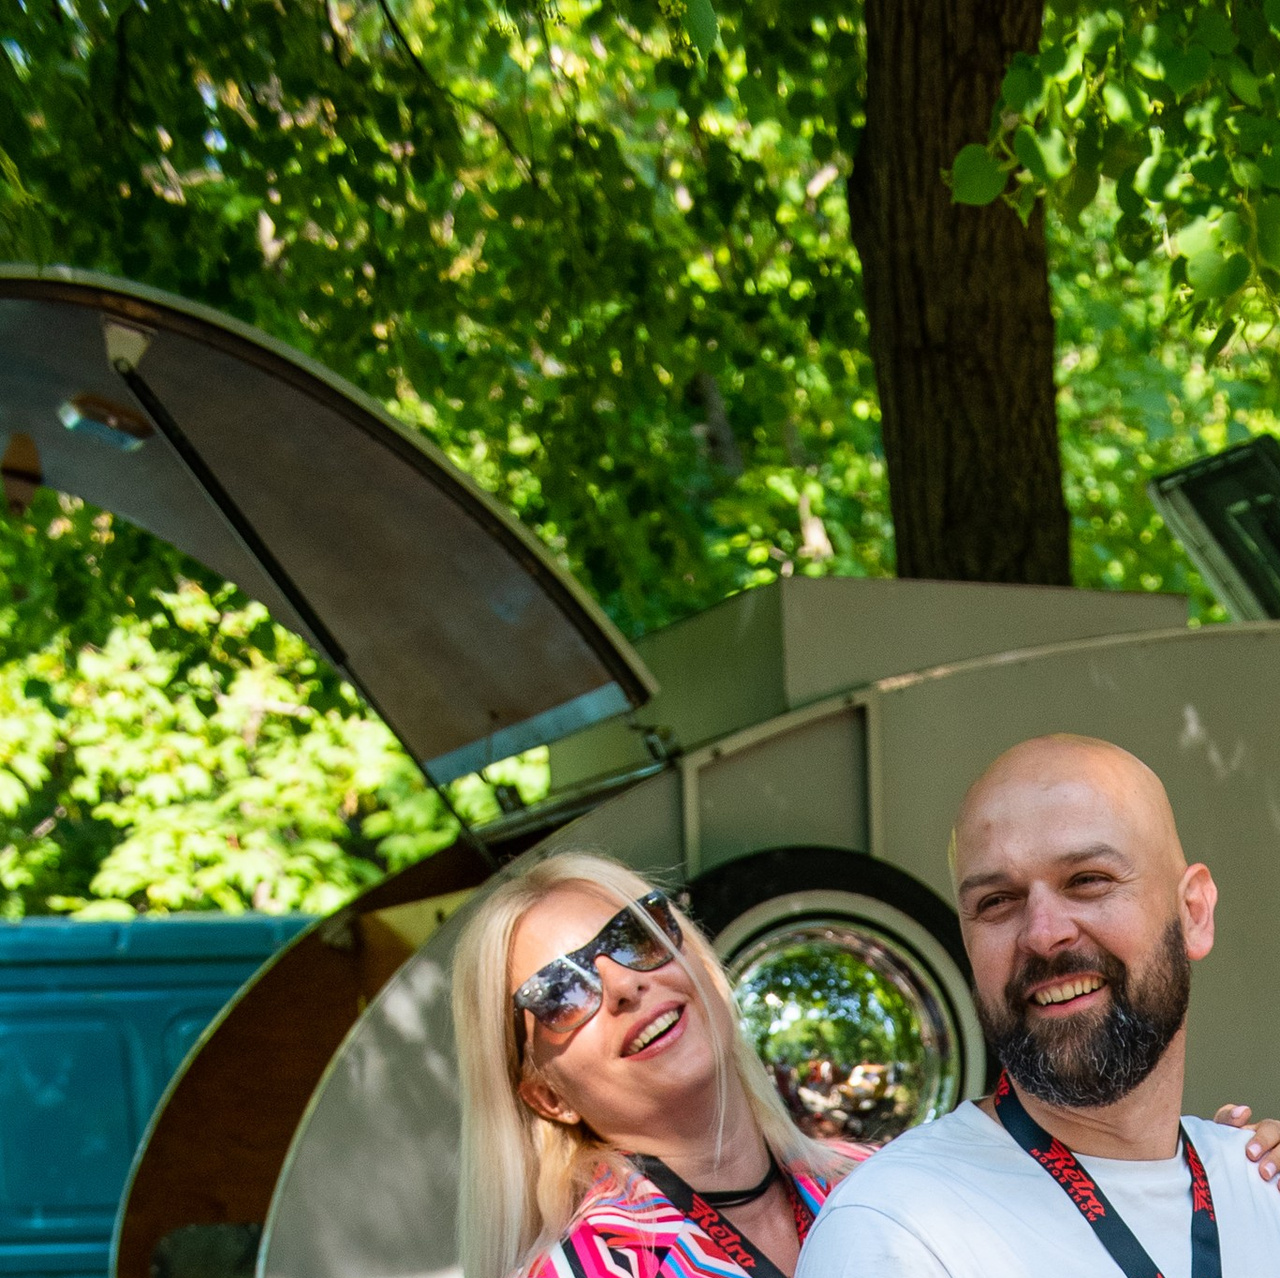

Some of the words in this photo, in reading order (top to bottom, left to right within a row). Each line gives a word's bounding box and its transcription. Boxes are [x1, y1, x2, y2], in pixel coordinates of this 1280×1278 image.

[1030, 1148, 1067, 1184] MOTOR
[1067, 1187, 1098, 1222] SHOW
[1043, 1138, 1106, 1217] Retro
[687, 1193, 757, 1268] Retro
